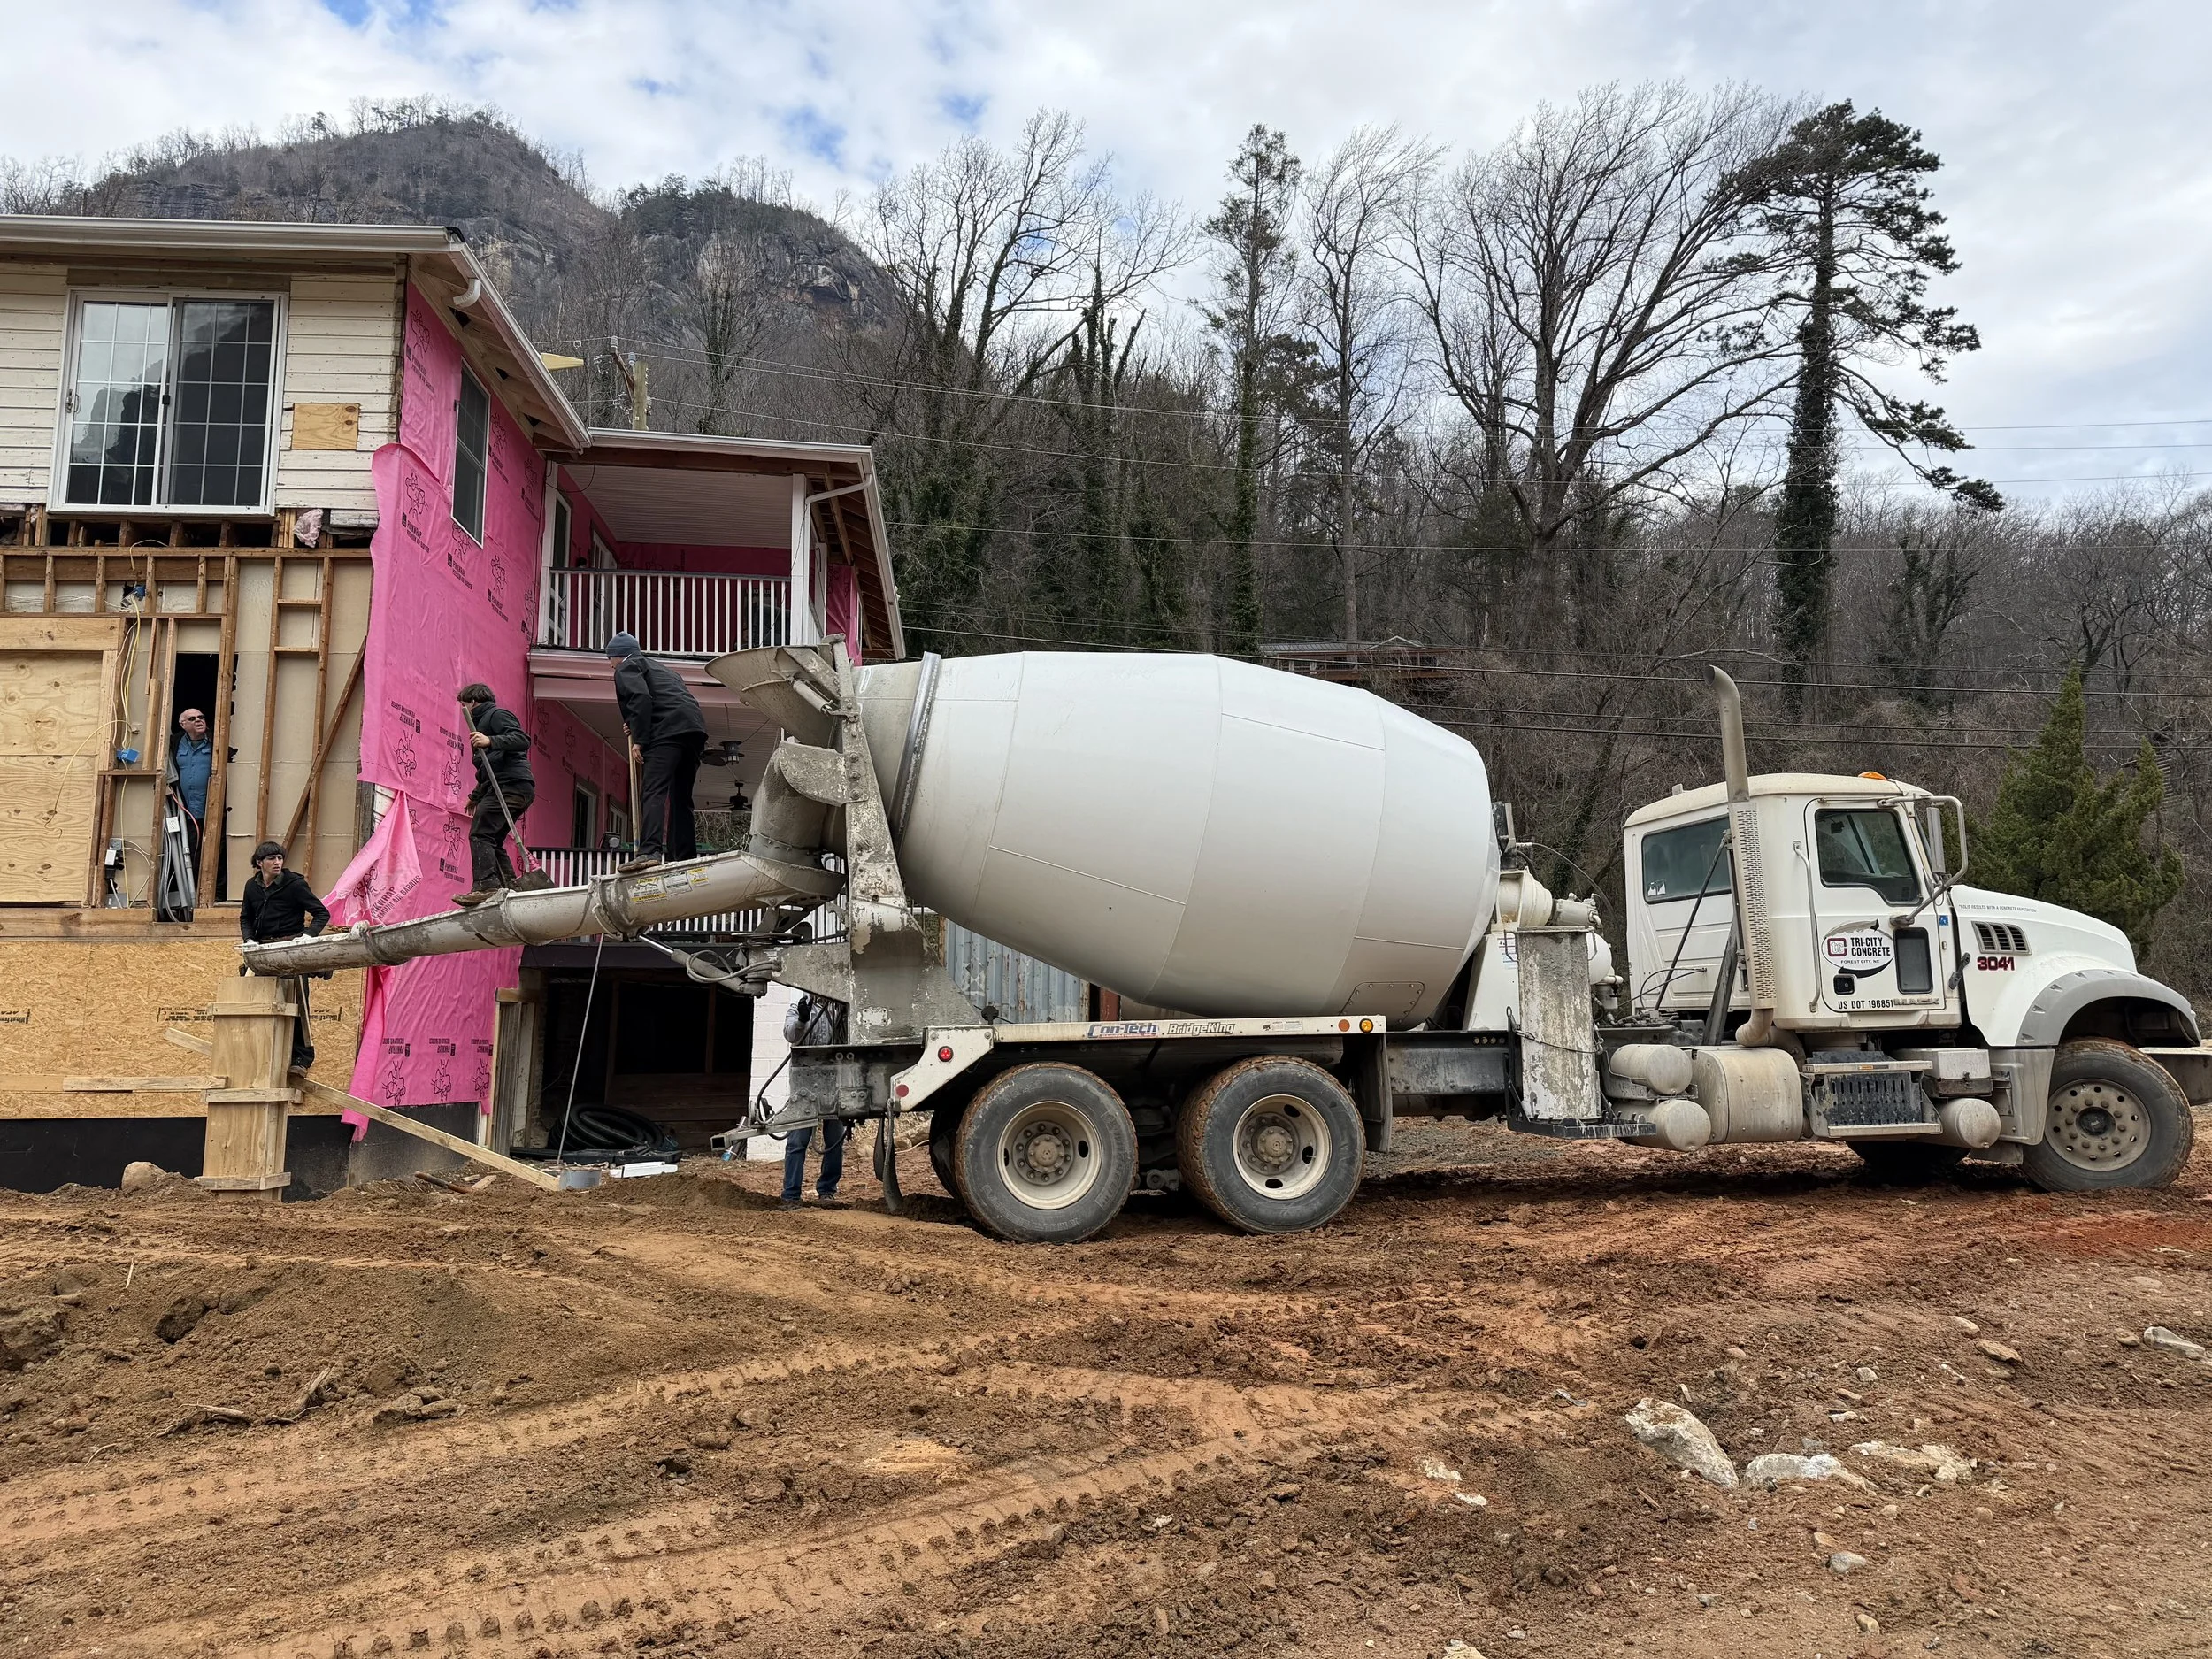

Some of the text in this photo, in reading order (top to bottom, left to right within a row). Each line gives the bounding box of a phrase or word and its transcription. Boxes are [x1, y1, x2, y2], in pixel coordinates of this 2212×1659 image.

[400, 875, 422, 896] BARRIER
[1850, 937, 1883, 947] TRI-CITY
[1851, 947, 1891, 956] CONCRETE
[1977, 956, 2015, 971] 3041
[1851, 1000, 1865, 1009] DOT
[1869, 999, 1893, 1009] 196851
[1087, 1022, 1236, 1038] Con-Tech BridgeKing
